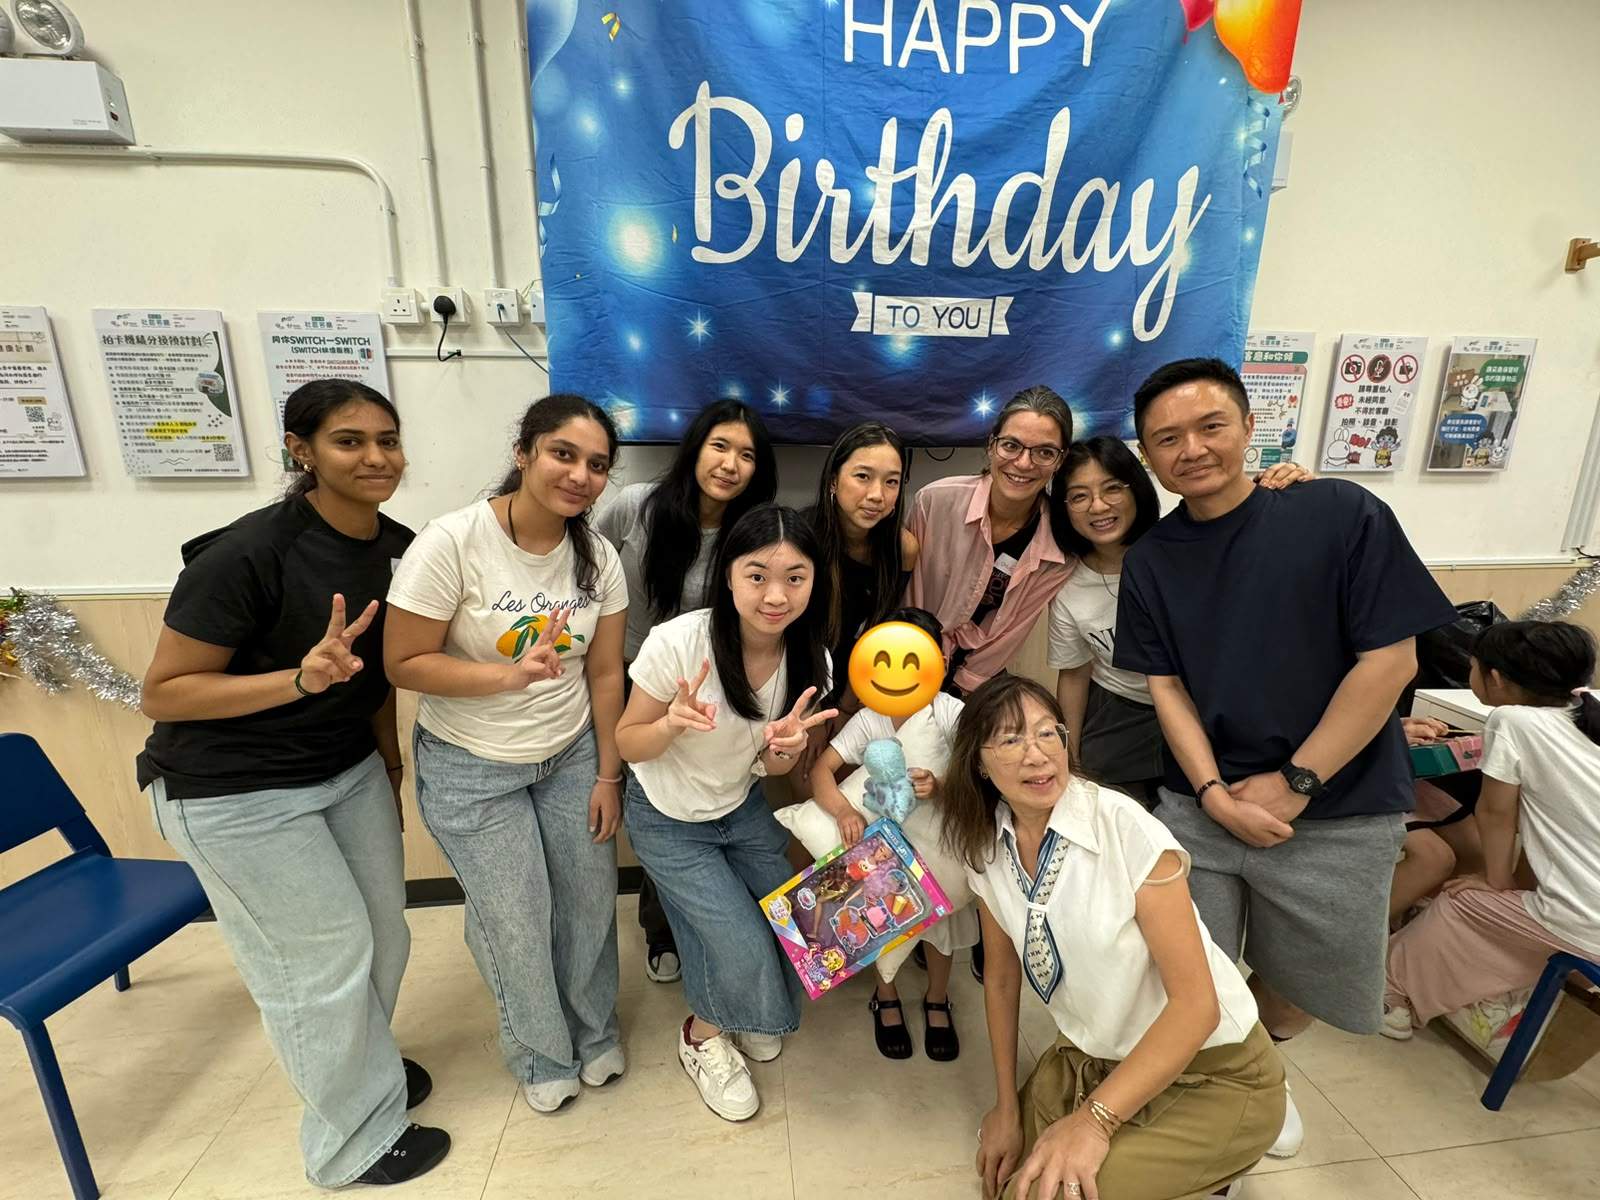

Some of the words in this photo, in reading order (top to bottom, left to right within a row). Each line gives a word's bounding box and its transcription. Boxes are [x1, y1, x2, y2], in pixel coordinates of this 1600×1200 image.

[844, 0, 1112, 74] HAPPY
[669, 80, 1212, 342] Birthday
[887, 305, 920, 328] TO
[933, 306, 982, 330] YOU
[492, 591, 526, 612] Les
[531, 592, 590, 615] Oranges
